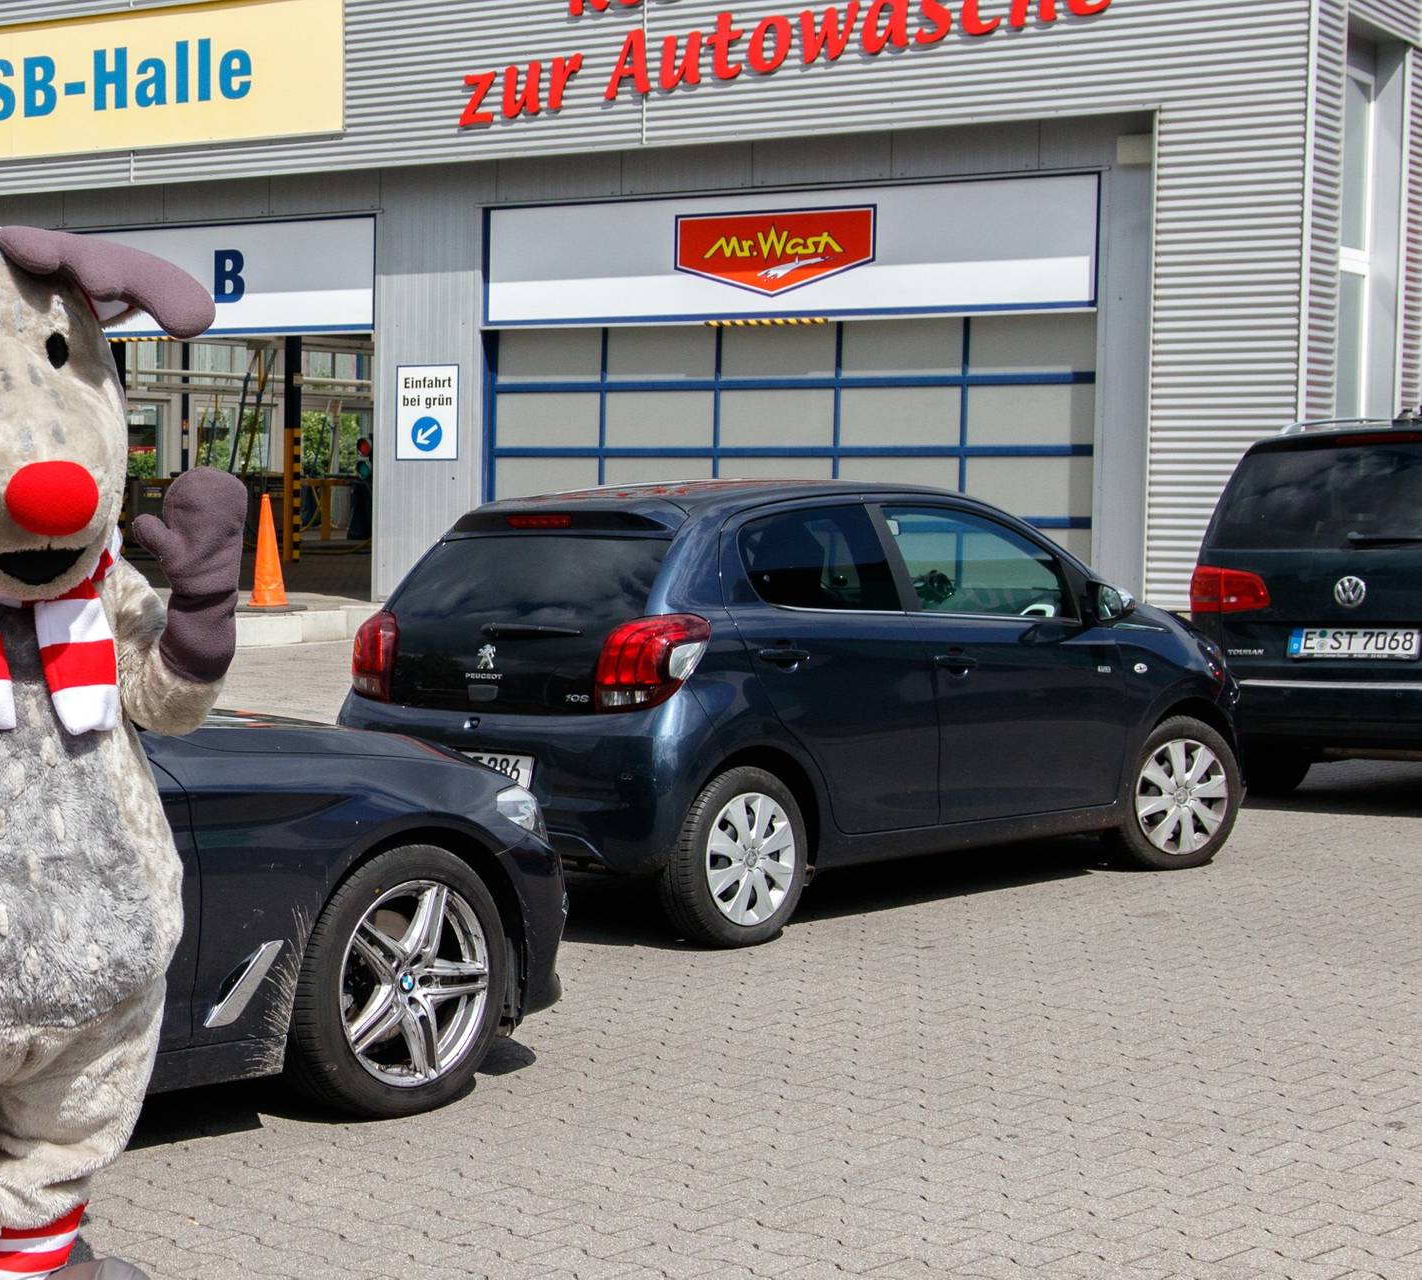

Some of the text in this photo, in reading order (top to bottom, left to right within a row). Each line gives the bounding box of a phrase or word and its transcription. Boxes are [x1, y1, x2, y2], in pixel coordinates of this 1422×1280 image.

[459, 52, 583, 127] zur
[214, 249, 245, 304] B
[404, 377, 452, 389] Einfahrt
[403, 394, 452, 409] bei grün
[1303, 631, 1414, 651] E ST 7068
[465, 672, 503, 680] PEUGEOT
